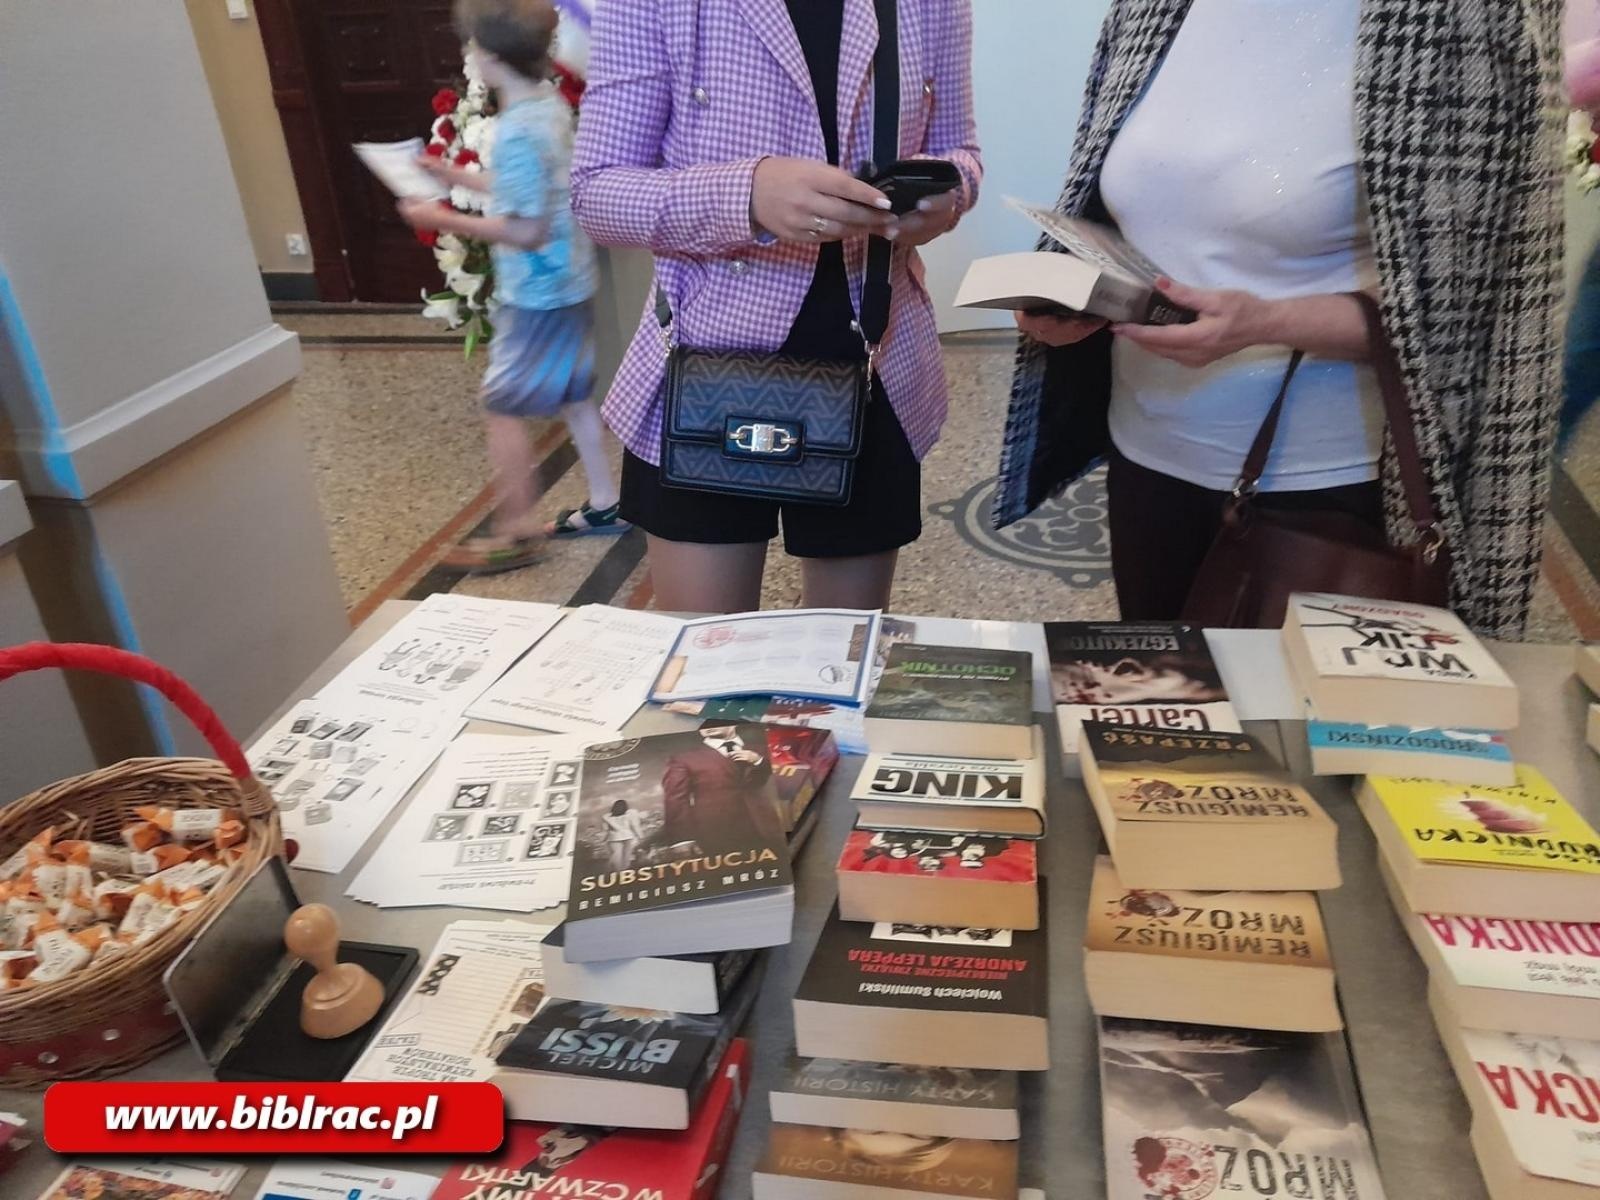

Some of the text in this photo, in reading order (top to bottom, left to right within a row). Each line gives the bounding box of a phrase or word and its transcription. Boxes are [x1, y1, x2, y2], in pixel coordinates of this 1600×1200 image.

[1068, 635, 1181, 651] EGZEKUTO
[900, 661, 1017, 676] OCHOTNIK
[1102, 731, 1253, 752] PRZEPAŚĆ
[870, 769, 1022, 799] KING
[1184, 784, 1300, 805] MRÓZ
[1134, 800, 1310, 819] REMIGIUSZ
[580, 848, 778, 892] SUBSTYTUCJA
[579, 868, 779, 911] REMIGIUSZ MRÓZ
[1179, 907, 1306, 936] MRÓZ
[1111, 925, 1312, 959] REMIGIUSZ
[847, 949, 1028, 972] ANDRZEJA LEPPERA
[858, 982, 1003, 1001] Wojciech Sumliński
[538, 1027, 681, 1064] BUSSI
[547, 1052, 655, 1074] MICHEL
[793, 1076, 995, 1101] KARTY HISTORII
[460, 1164, 664, 1200] W CZWARTKI
[779, 1155, 994, 1191] KARTY HISTORII
[1214, 1146, 1360, 1200] MRÓZ
